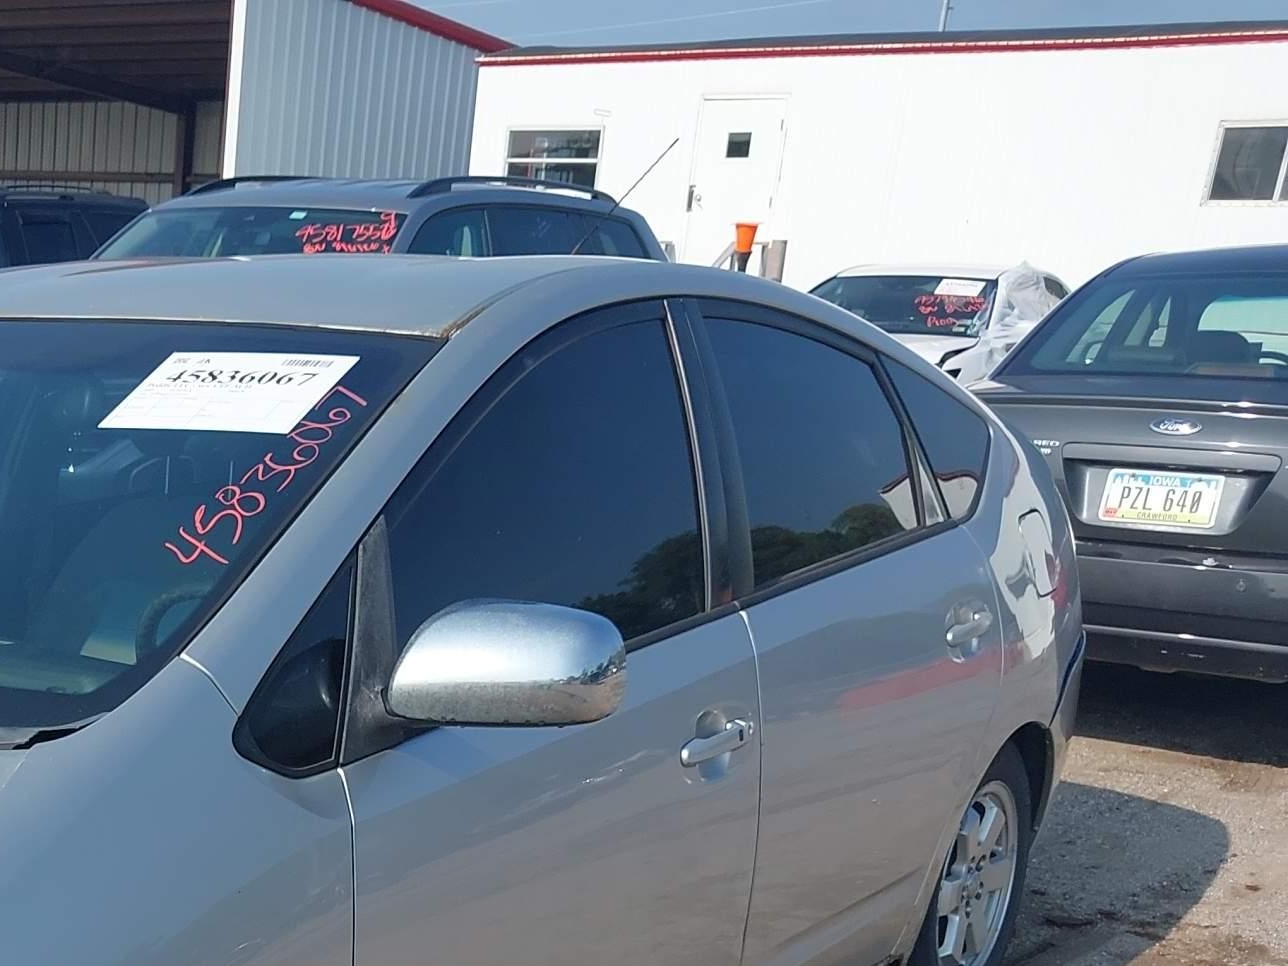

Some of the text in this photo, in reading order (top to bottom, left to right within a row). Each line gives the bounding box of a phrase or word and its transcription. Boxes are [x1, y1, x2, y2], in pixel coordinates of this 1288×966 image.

[165, 368, 320, 386] 45836067
[164, 385, 369, 566] 45836067
[1149, 477, 1181, 488] IOWA
[1118, 486, 1203, 515] PZL 640
[1136, 511, 1179, 521] CRAWFORD
